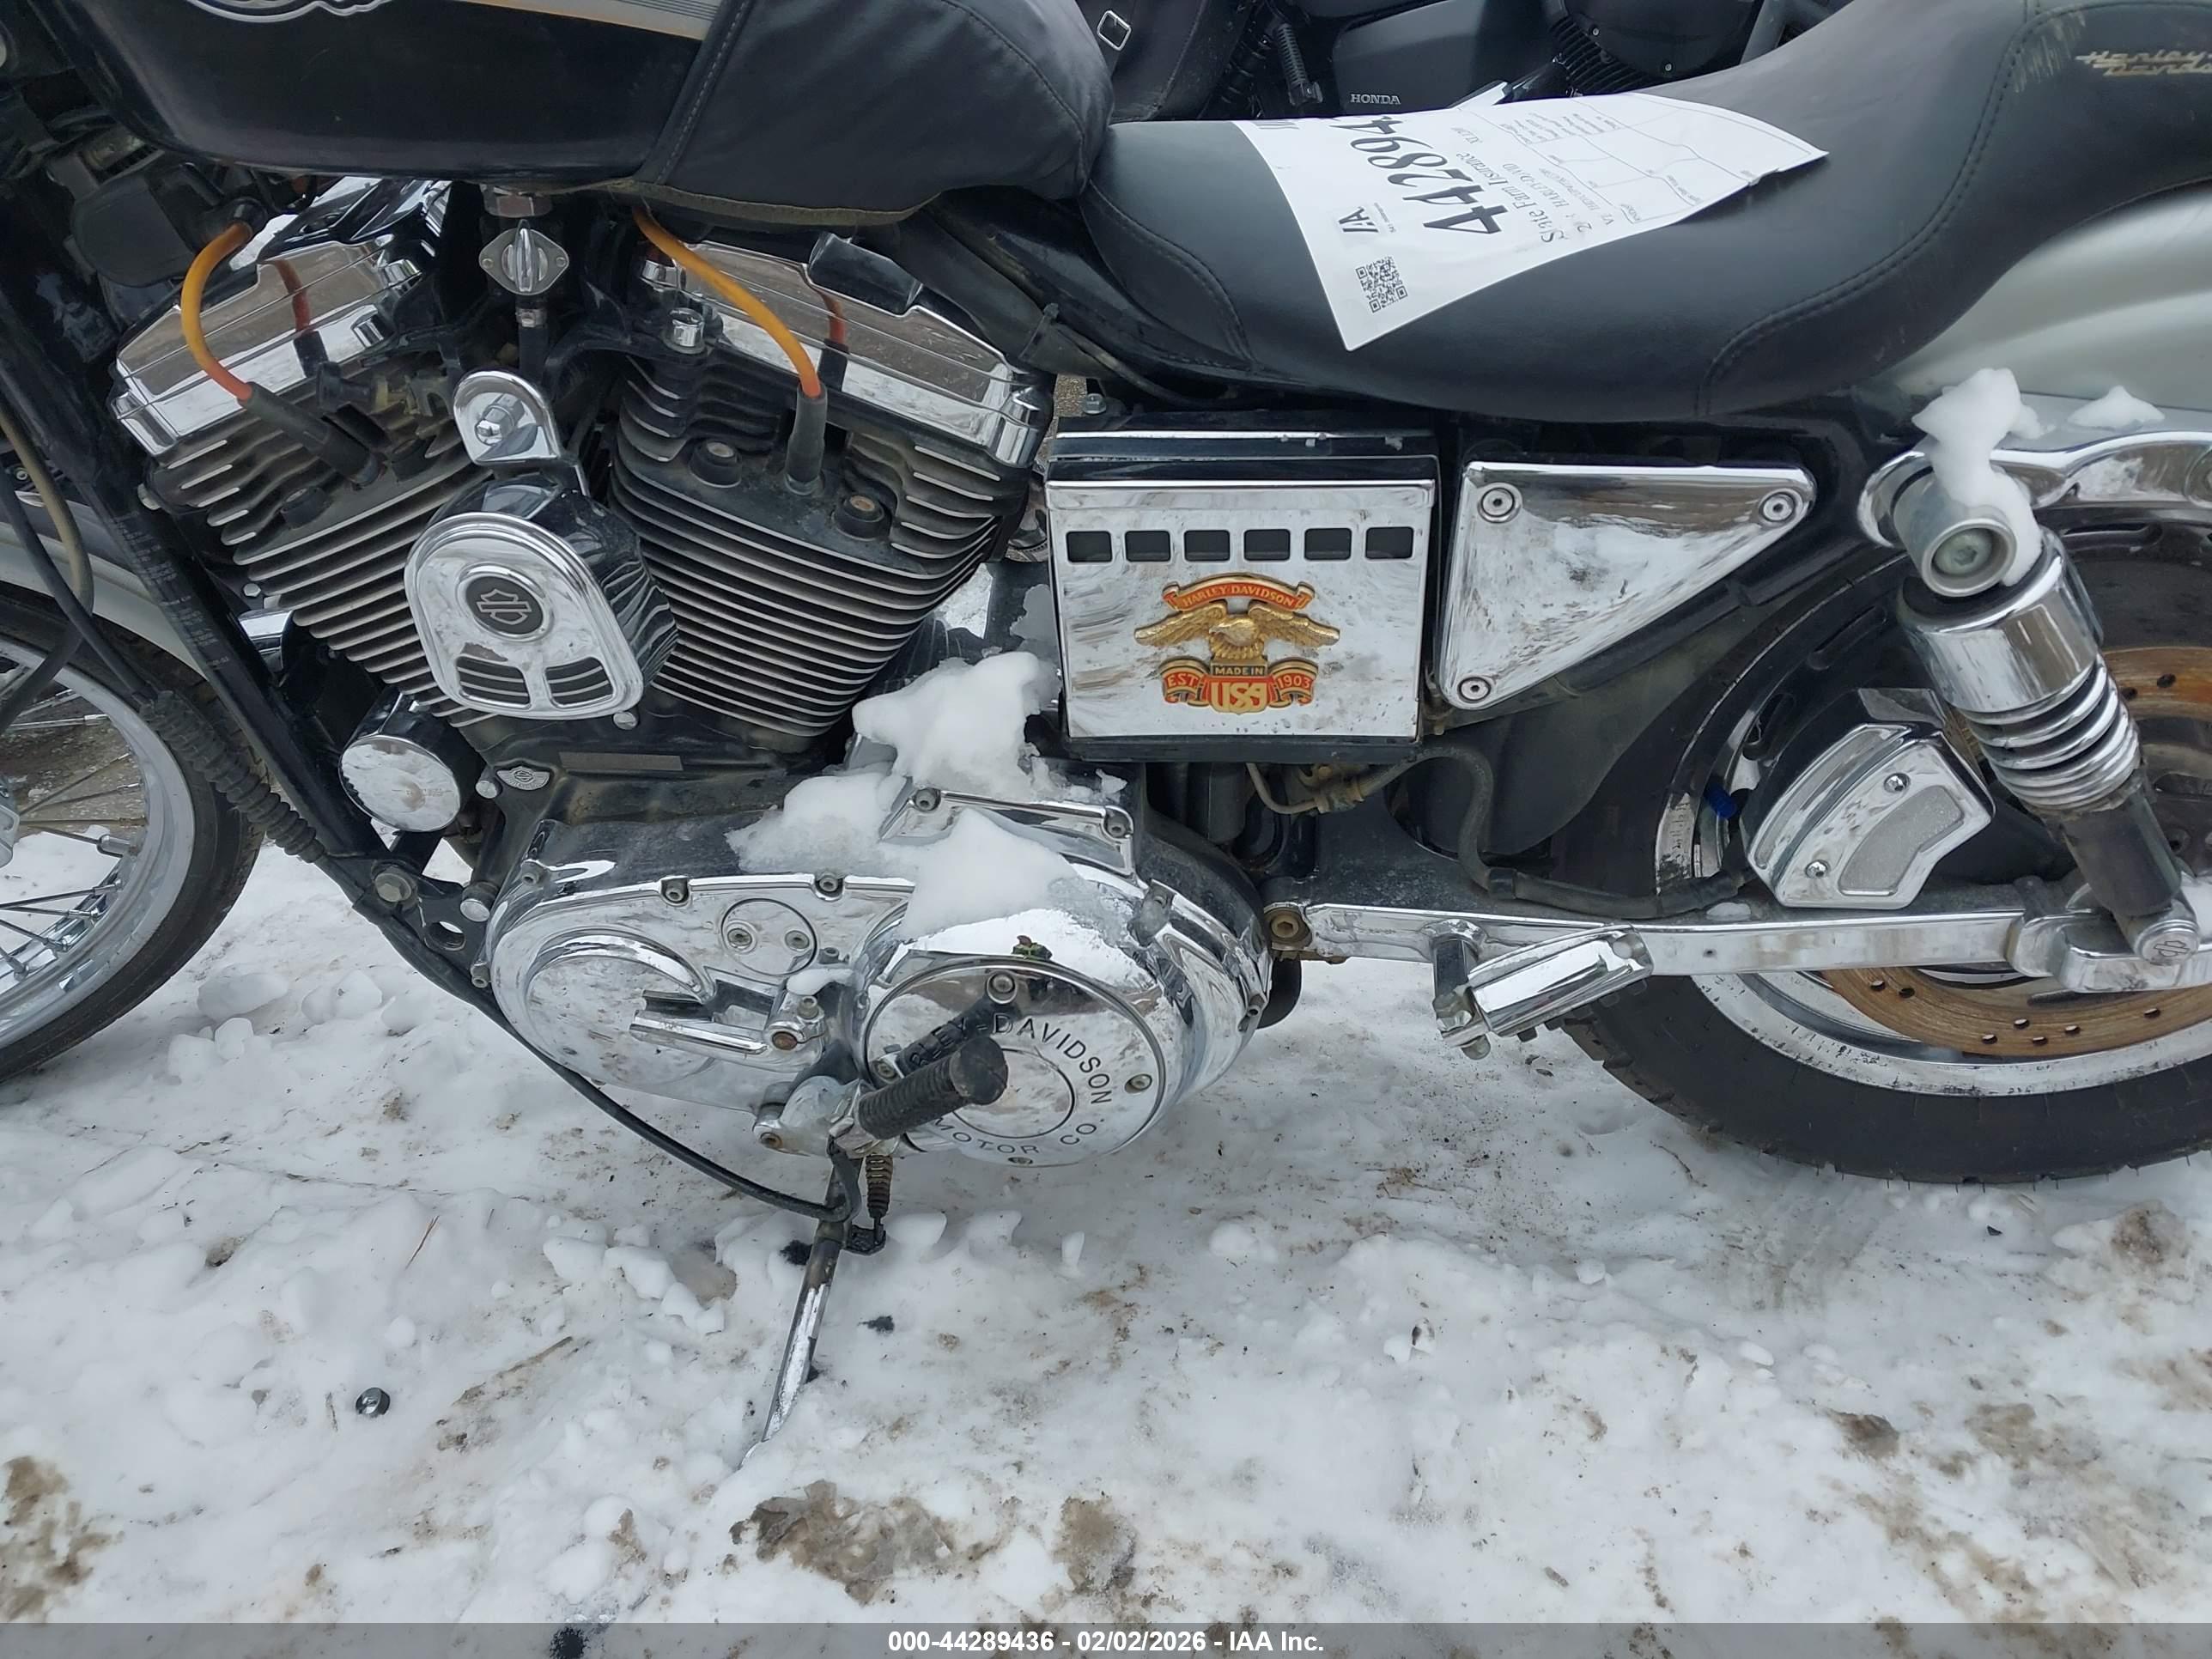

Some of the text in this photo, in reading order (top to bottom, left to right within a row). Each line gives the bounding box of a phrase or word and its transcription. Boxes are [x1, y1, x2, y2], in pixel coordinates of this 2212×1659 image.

[1350, 94, 1401, 105] HONDA
[1328, 116, 1510, 234] 442894
[1214, 665, 1264, 676] MADE IN
[1278, 675, 1311, 689] 1903
[1211, 682, 1268, 714] USA
